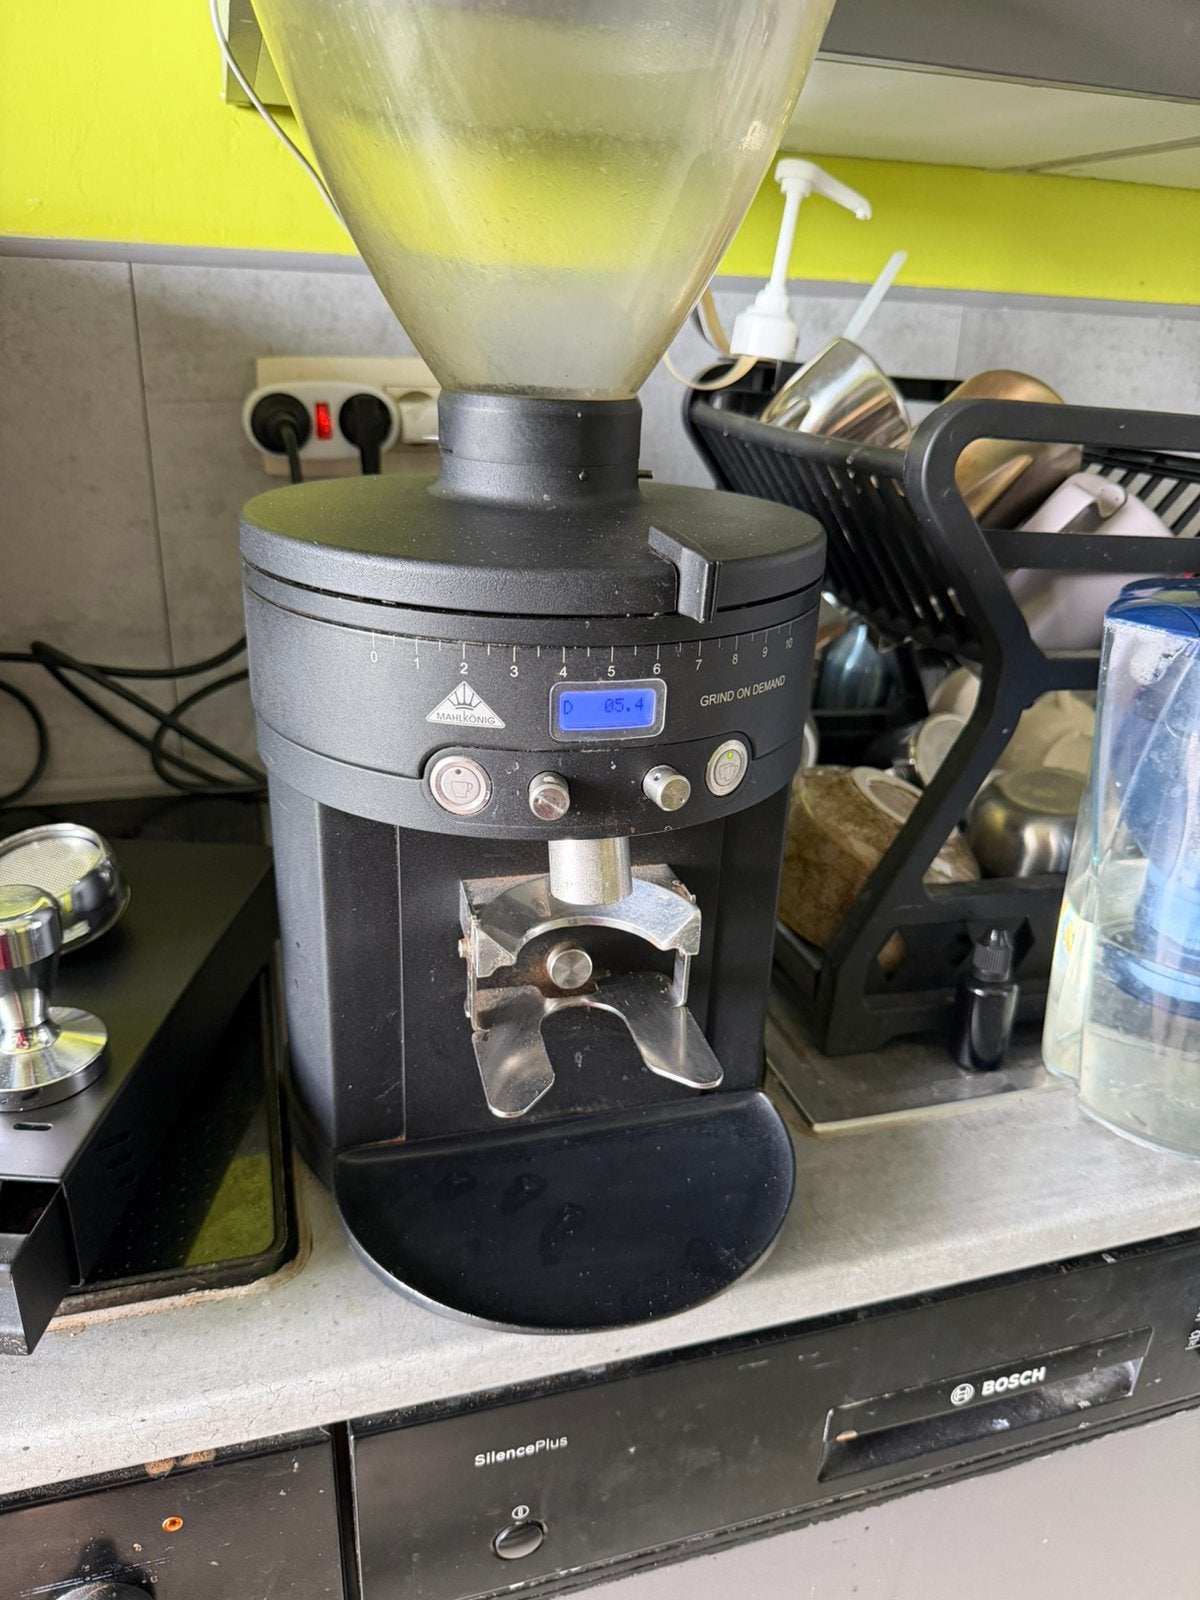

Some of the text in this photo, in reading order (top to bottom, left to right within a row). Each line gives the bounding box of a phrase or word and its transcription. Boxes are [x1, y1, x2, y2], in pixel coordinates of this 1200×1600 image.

[370, 637, 794, 678] 0 1 2 3 4 5 6 7 8 9 10
[563, 697, 644, 715] D 05.4
[700, 675, 786, 707] GRIND ON DEMAND
[436, 711, 496, 725] MAHLKÖNIG
[981, 1366, 1047, 1396] BOSCH
[474, 1436, 569, 1467] SilencePlus
